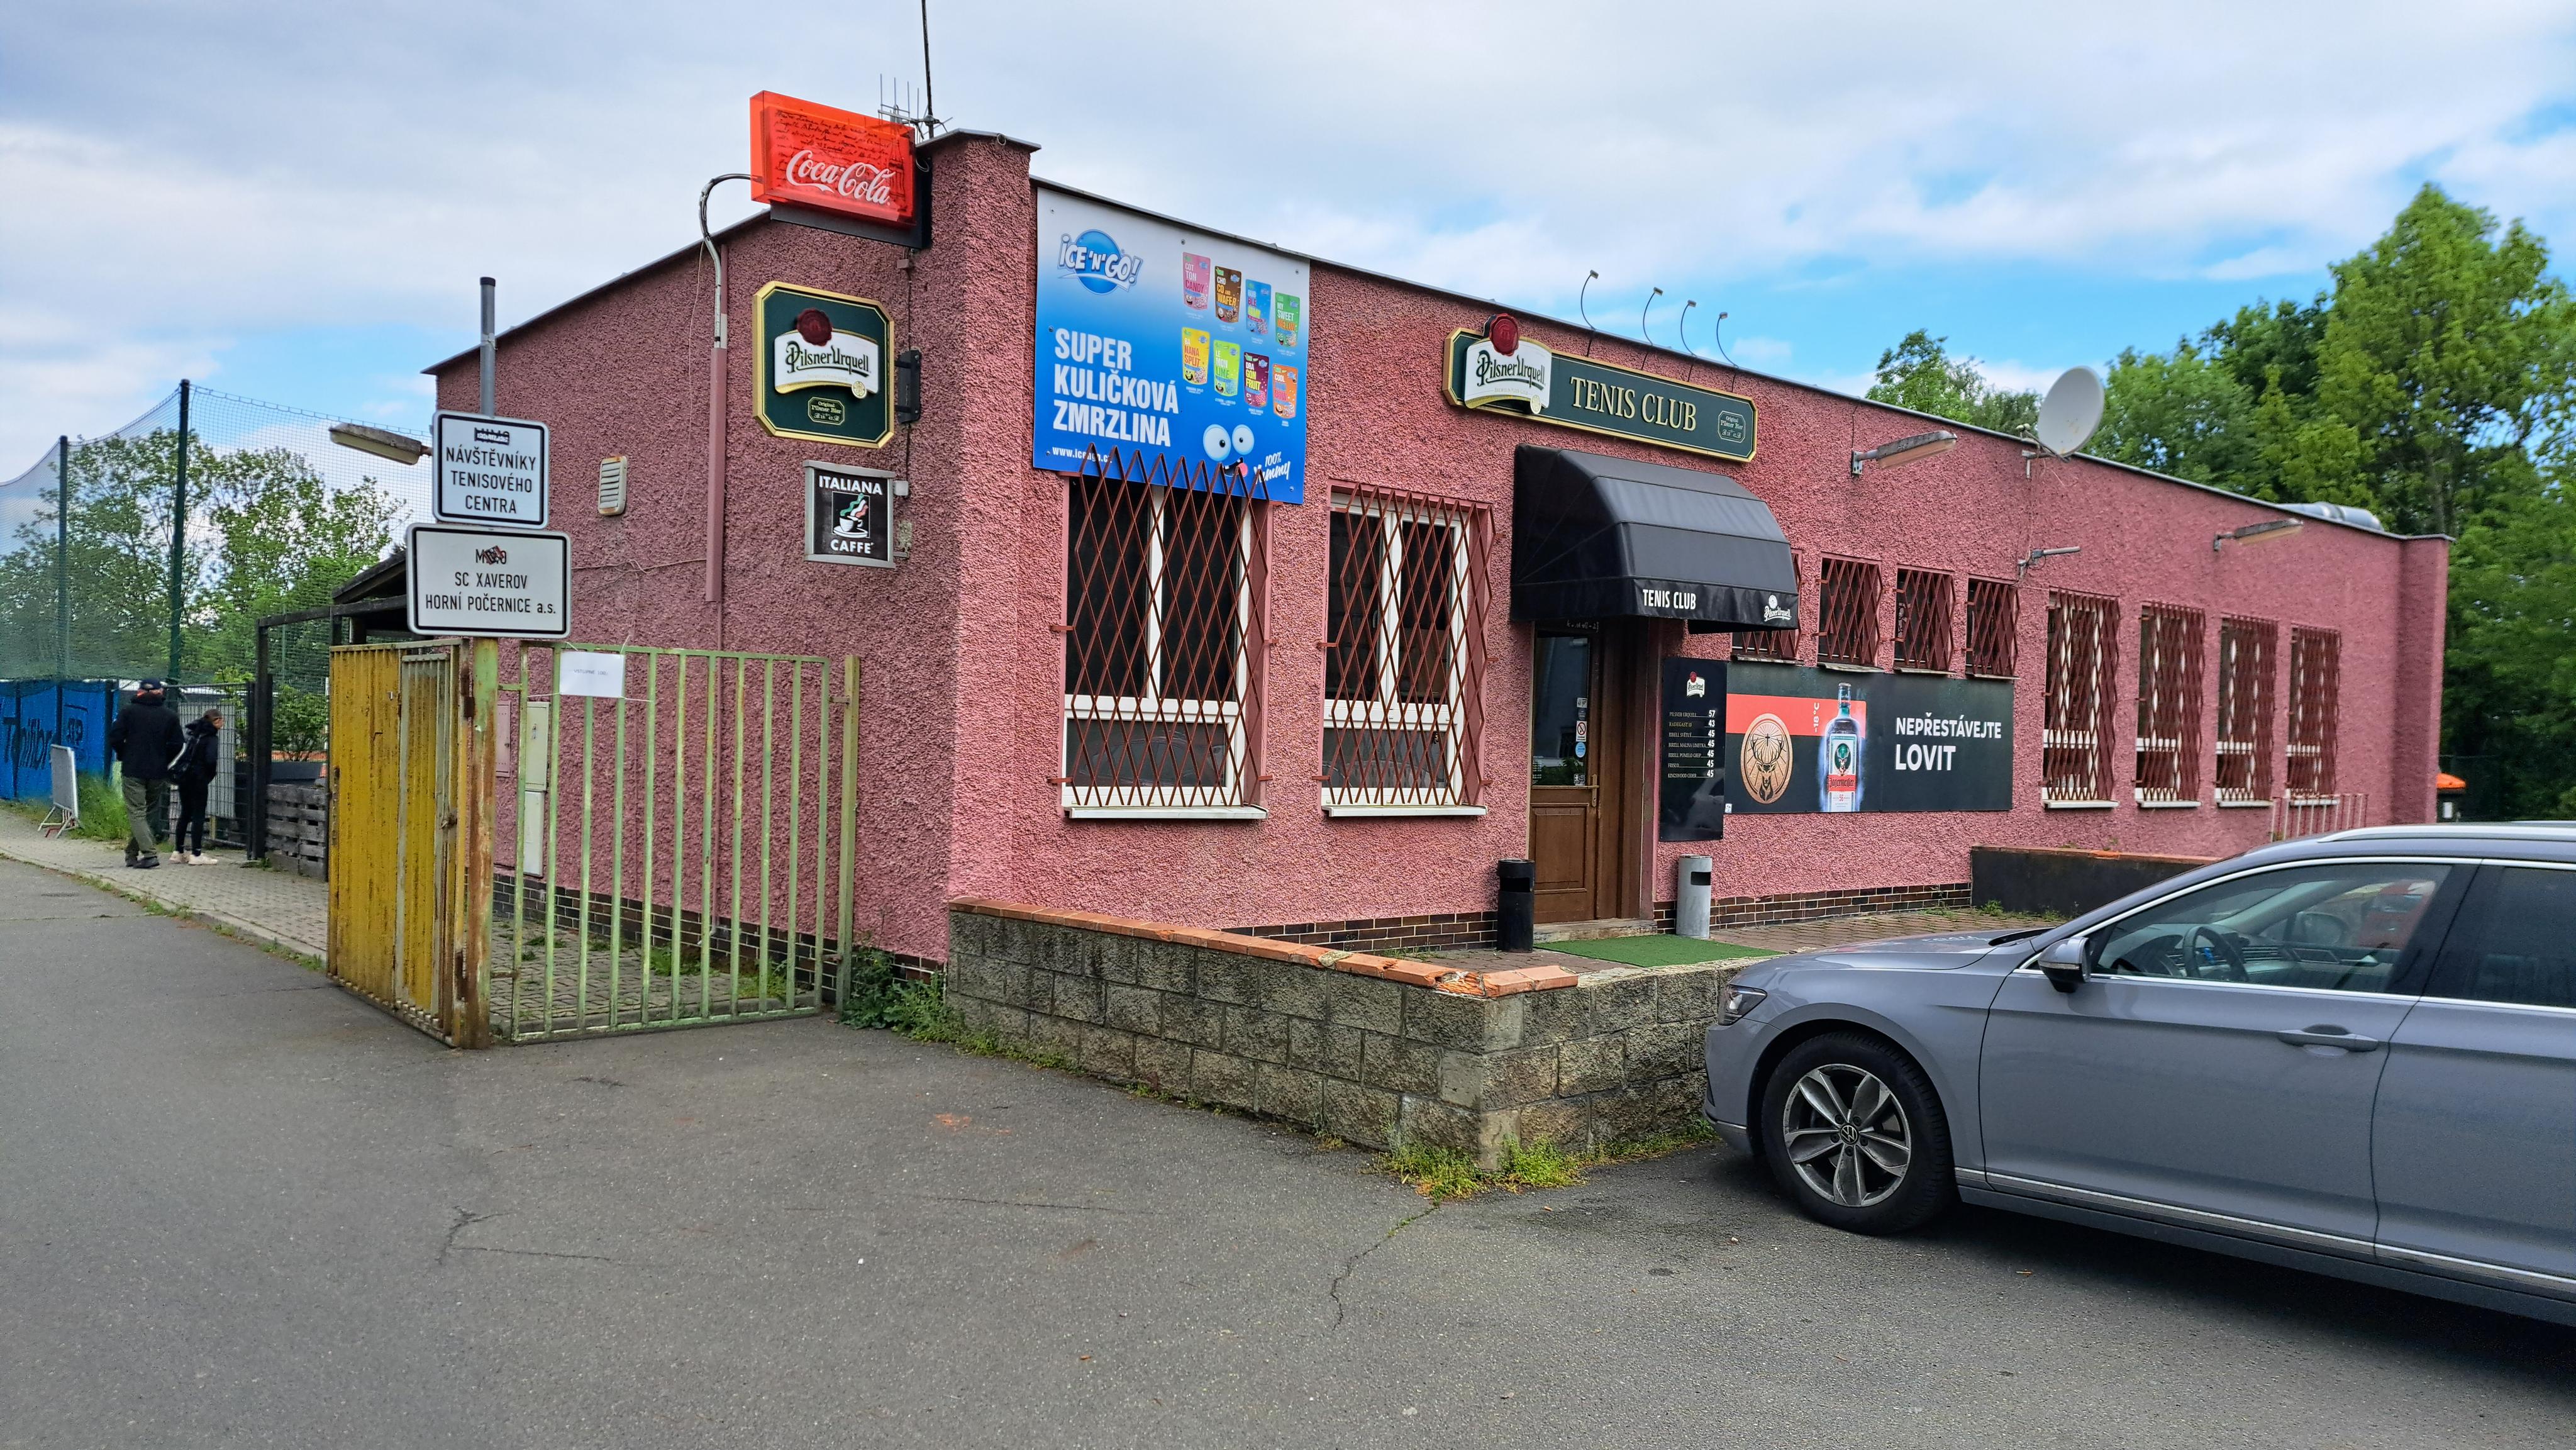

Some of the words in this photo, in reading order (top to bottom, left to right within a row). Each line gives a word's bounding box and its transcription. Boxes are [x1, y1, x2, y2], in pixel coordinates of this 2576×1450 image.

[786, 149, 896, 205] Coca-Cola
[1104, 254, 1141, 283] GO!
[1185, 270, 1197, 281] TON
[1185, 280, 1205, 294] CANDY
[1216, 276, 1226, 285] CHO
[1217, 293, 1237, 306] WAFER
[1277, 310, 1294, 321] SWEET
[786, 340, 831, 374] Pilsner
[831, 345, 869, 376] Urquell
[1055, 328, 1132, 371] SUPER
[1184, 345, 1199, 357] NANA
[1184, 355, 1201, 367] SPLIT
[1476, 349, 1518, 387] Pilsner
[1516, 354, 1545, 388] Urquell
[1054, 363, 1179, 414] KULIČKOVÁ
[1246, 377, 1262, 391] FRUIT
[1570, 376, 1636, 420] TENIS
[1641, 393, 1697, 432] CLUB
[1053, 399, 1171, 447] ZMRZLINA
[446, 445, 536, 471] NÁVŠTĚVNÍKY
[1265, 451, 1282, 467] 100%
[450, 471, 532, 493] TENISOVÉHO
[819, 475, 883, 496] ITALIANA
[465, 495, 516, 514] CENTRA
[476, 549, 507, 564] MO
[454, 571, 470, 587] SC
[476, 572, 528, 589] XAVEROV
[425, 591, 462, 610] HORNÍ
[467, 593, 531, 613] POČERNICE
[536, 602, 556, 614] a.s.
[1642, 588, 1670, 609] TENIS
[1674, 591, 1697, 610] CLUB
[1708, 719, 1715, 727] 43
[1709, 710, 1716, 718] 57
[1896, 711, 2002, 739] NEPŘESTÁVEJTE
[1707, 749, 1714, 757] 45
[1895, 744, 1956, 771] LOVIT
[1707, 759, 1714, 767] 45
[1706, 769, 1714, 778] 45
